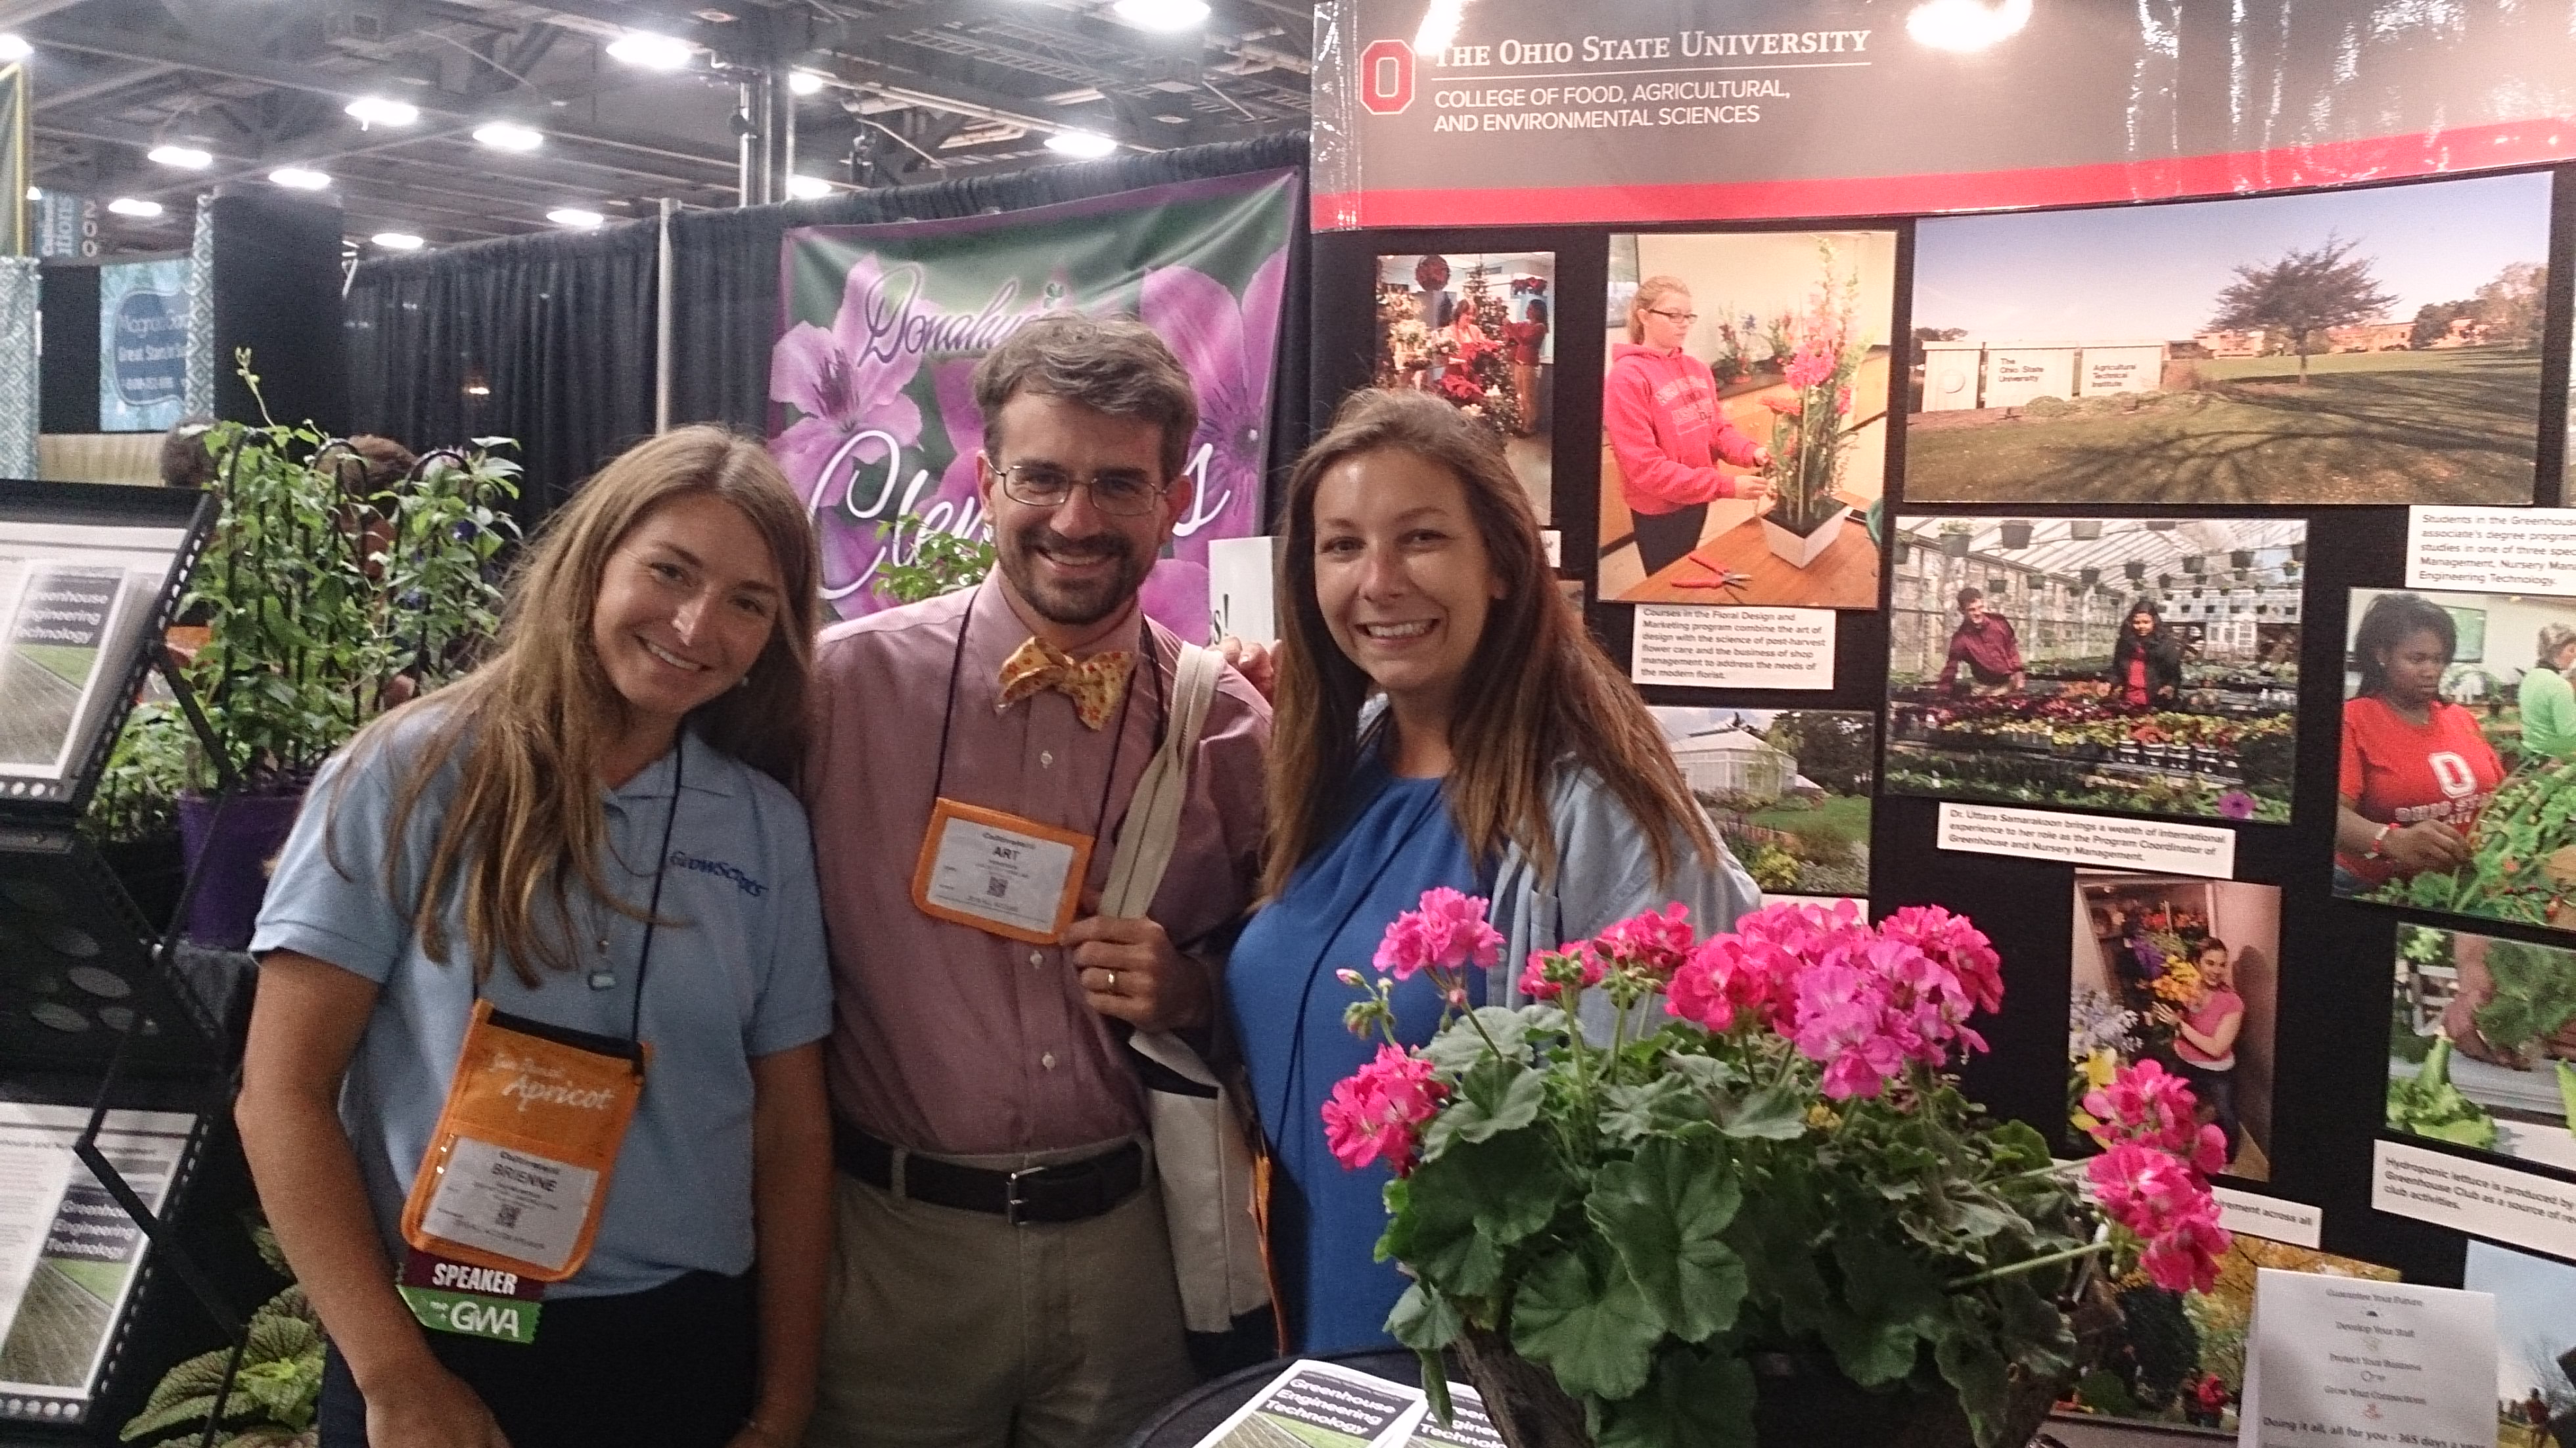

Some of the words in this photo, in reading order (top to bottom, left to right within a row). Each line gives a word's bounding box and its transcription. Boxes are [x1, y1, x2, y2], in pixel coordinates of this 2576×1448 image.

[1499, 39, 1573, 65] OHIO
[1582, 35, 1670, 62] STATE
[1680, 30, 1872, 58] UNIVERSITY
[1435, 89, 1525, 108] COLLEGE
[1530, 87, 1559, 106] OF
[1564, 85, 1627, 105] FOOD,
[1632, 79, 1791, 101] AGRICULTURAL,
[1434, 114, 1479, 133] AND
[1483, 108, 1653, 131] ENVIRONMENTAL
[1659, 105, 1760, 126] SCIENCES
[2422, 514, 2472, 524] Students
[2476, 515, 2485, 524] in
[2489, 516, 2507, 524] the
[2422, 530, 2482, 538] associate's
[2486, 530, 2525, 541] degree
[2421, 543, 2460, 553] studies
[2465, 544, 2475, 553] in
[2502, 545, 2514, 554] of
[2517, 547, 2546, 555] three
[2420, 557, 2496, 568] Management,
[2501, 560, 2544, 571] Nursery
[2419, 571, 2486, 583] Engineering
[2490, 573, 2557, 587] Technology.
[1643, 620, 1690, 631] Marketing
[1692, 623, 1732, 633] program
[1734, 624, 1776, 633] combine
[1644, 608, 1681, 617] Courses
[1683, 608, 1693, 617] in
[1713, 610, 1739, 619] Floral
[1741, 612, 1776, 622] Design
[1643, 632, 1674, 643] design
[1766, 638, 1826, 646] post-harvest
[1641, 658, 1703, 667] management
[1716, 660, 1754, 668] address
[1734, 648, 1776, 657] business
[1790, 650, 1814, 660] shop
[1659, 669, 1694, 678] modern
[1696, 670, 1726, 679] florist.
[1949, 823, 2004, 834] experience
[2018, 828, 2035, 837] her
[2037, 831, 2058, 840] role
[2073, 834, 2090, 843] the
[2092, 835, 2138, 848] Program
[2139, 840, 2203, 854] Coordinator
[1950, 809, 1964, 818] Dr.
[2065, 820, 2096, 832] brings
[2107, 825, 2143, 835] wealth
[2158, 828, 2226, 844] international
[992, 846, 1021, 861] ART
[1948, 834, 2009, 848] Greenhouse
[2032, 842, 2072, 855] Nursery
[2074, 846, 2146, 862] Management.
[501, 1074, 615, 1113] Apricot
[492, 1162, 557, 1192] BRIENNE
[2385, 1157, 2450, 1179] Hydroponic
[2451, 1171, 2489, 1188] lettuce
[2491, 1181, 2501, 1190] is
[2504, 1186, 2558, 1204] produced
[2560, 1197, 2574, 1211] by
[2383, 1185, 2408, 1197] club
[2410, 1192, 2461, 1210] activities.
[2384, 1171, 2452, 1194] Greenhouse
[2453, 1186, 2480, 1200] Club
[2482, 1195, 2495, 1204] as
[2507, 1201, 2546, 1217] source
[2547, 1211, 2561, 1219] of
[53, 1218, 135, 1241] Engineering
[2263, 1209, 2297, 1223] across
[2299, 1216, 2313, 1226] all
[46, 1238, 126, 1260] Technology
[432, 1262, 518, 1296] SPEAKER
[449, 1300, 520, 1338] GWA
[1276, 1389, 1383, 1426] Engineering
[1290, 1378, 1396, 1414] Greenhouse
[1266, 1399, 1369, 1434] Technology
[2263, 1416, 2297, 1432] Doing
[2347, 1426, 2364, 1437] for
[2365, 1431, 2388, 1441] you
[2399, 1432, 2419, 1444] 365
